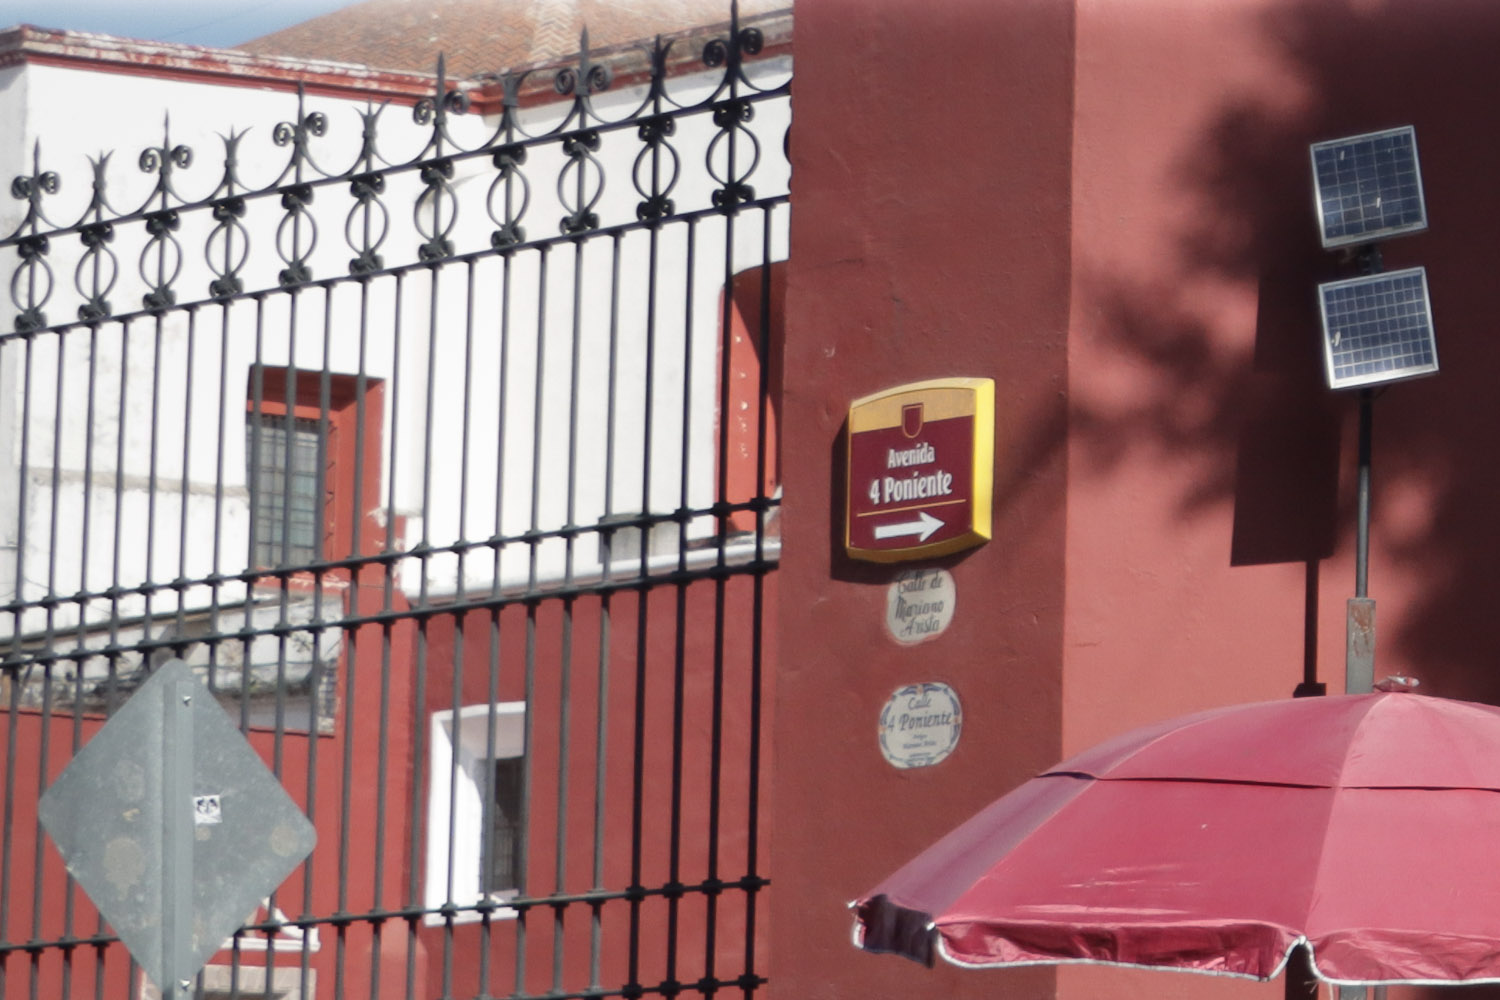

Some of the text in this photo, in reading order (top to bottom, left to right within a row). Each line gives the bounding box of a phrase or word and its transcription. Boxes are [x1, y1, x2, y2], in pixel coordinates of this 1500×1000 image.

[888, 442, 935, 468] Avenida
[869, 470, 952, 504] 4 Poniente
[895, 596, 944, 622] Mariano
[908, 693, 932, 710] Calle
[899, 711, 952, 731] Poniente
